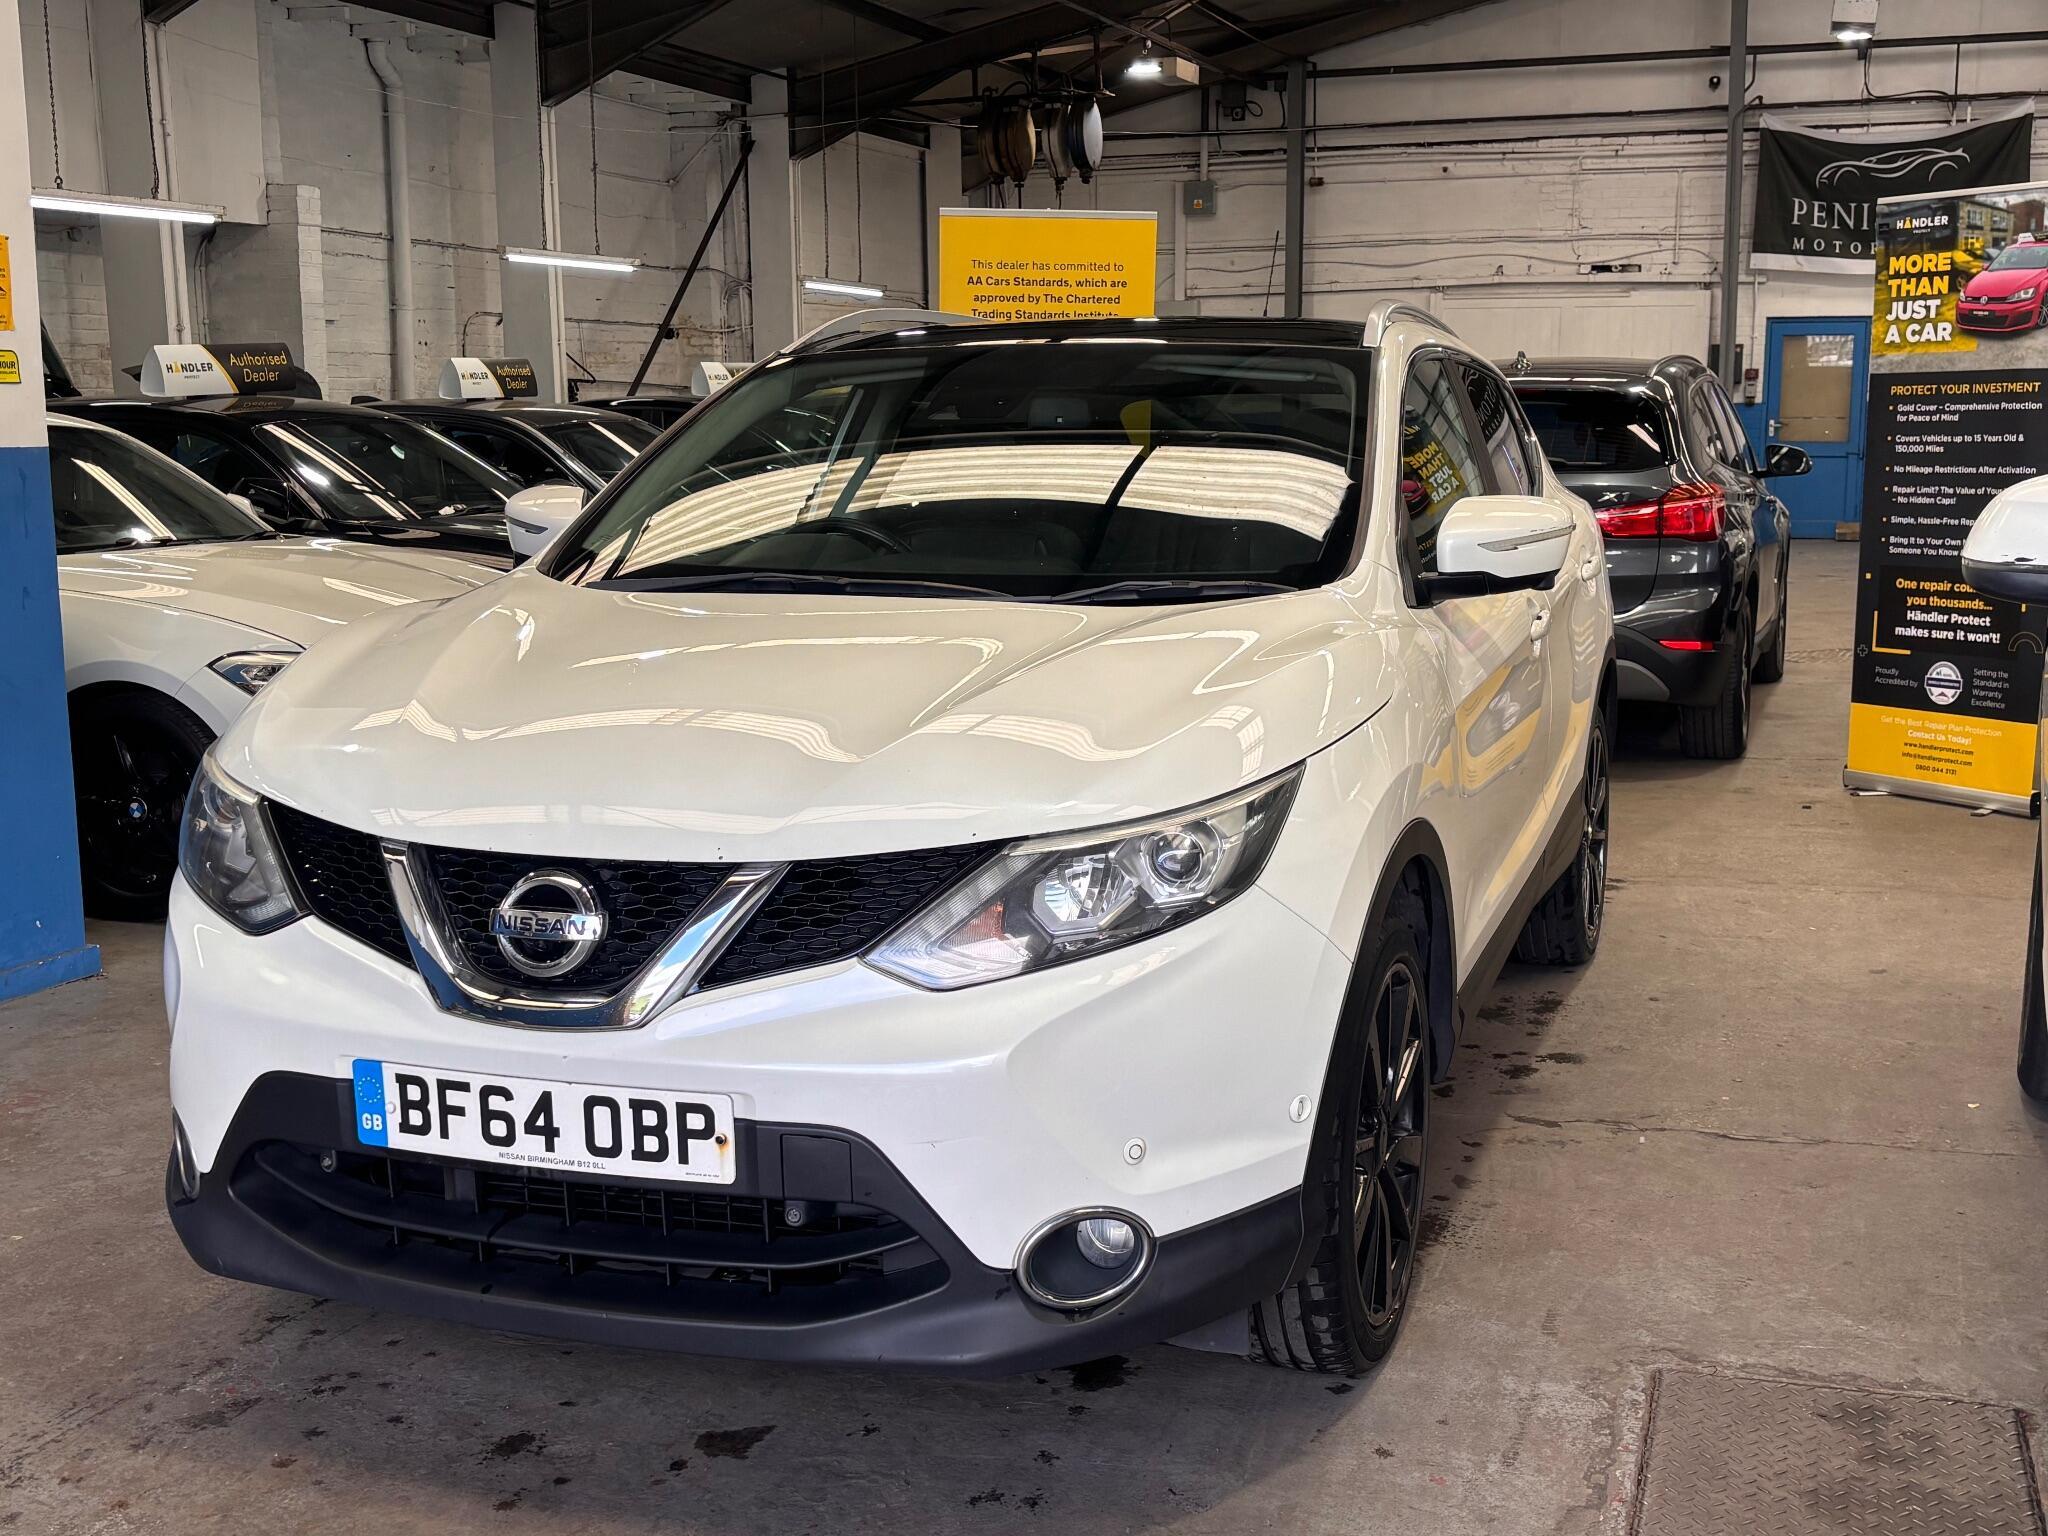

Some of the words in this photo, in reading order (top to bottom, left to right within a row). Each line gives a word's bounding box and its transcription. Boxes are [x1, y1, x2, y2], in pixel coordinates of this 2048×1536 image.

[1791, 197, 1877, 231] PENI
[971, 259, 993, 269] This
[996, 260, 1029, 270] dealer
[1032, 261, 1050, 270] has
[1054, 261, 1110, 272] committed
[1114, 263, 1124, 272] to
[1889, 252, 1952, 275] MORE
[967, 276, 983, 286] AA
[986, 276, 1011, 286] Cars
[1013, 277, 1072, 288] Standards,
[1075, 278, 1107, 288] which
[1888, 276, 1949, 297] THAN
[973, 293, 1025, 304] approved
[1028, 294, 1041, 304] by
[1043, 294, 1063, 304] The
[1066, 294, 1121, 305] Chartered
[971, 308, 1012, 320] Trading
[1015, 309, 1070, 320] Standards
[1886, 300, 1941, 321] JUST
[1884, 324, 1900, 344] A
[1906, 322, 1952, 343] CAR
[230, 351, 287, 367] Authorised
[243, 369, 279, 383] Dealer
[506, 377, 528, 389] Dealer
[1891, 385, 1937, 396] PROTECT
[1940, 384, 1970, 395] YOUR
[1973, 382, 2041, 394] INVESTMENT
[1898, 403, 1915, 412] Gold
[1945, 402, 1999, 412] Comprehensive
[2001, 401, 2043, 410] Protection
[1897, 414, 1907, 422] for
[1909, 414, 1930, 422] Peace
[1941, 413, 1959, 421] Mind
[1896, 435, 1920, 443] Covers
[1922, 434, 1951, 442] Vehicles
[1974, 434, 1981, 442] 15
[1983, 434, 2002, 442] Years
[2003, 434, 2016, 442] Old
[2018, 434, 2024, 442] &
[1895, 445, 1924, 453] 150,000
[1926, 444, 1944, 453] Miles
[1894, 465, 1904, 473] No
[1906, 465, 1932, 474] Mileage
[1934, 465, 1976, 474] Restrictions
[1978, 466, 1996, 474] After
[1998, 465, 2036, 474] Activation
[1892, 486, 1915, 495] Repair
[1917, 486, 1938, 494] Limit?
[1940, 486, 1954, 494] The
[1955, 486, 1975, 494] Value
[1977, 486, 1985, 494] of
[1898, 496, 1908, 504] No
[1909, 496, 1934, 504] Hidden
[1936, 497, 1956, 506] Caps!
[1890, 516, 1916, 525] Simple,
[1918, 516, 1959, 525] Hassle-Free
[1961, 518, 1975, 526] Rep
[1889, 536, 1908, 545] Bring
[1917, 537, 1925, 545] to
[1926, 537, 1943, 545] Your
[1944, 538, 1961, 546] Own
[1889, 546, 1921, 555] Someone
[1923, 547, 1937, 555] You
[1939, 548, 1959, 556] Know
[1896, 578, 1917, 589] One
[1920, 581, 1952, 592] repair
[1954, 583, 1976, 593] cou
[1906, 596, 1926, 607] you
[1929, 596, 1993, 610] thousands...
[1907, 610, 1949, 623] Händler
[1950, 613, 1991, 627] Protect
[1895, 626, 1929, 638] makes
[1931, 629, 1954, 640] sure
[1957, 629, 1965, 641] it
[1875, 666, 1899, 676] Proudly
[1973, 668, 1997, 678] Setting
[1998, 670, 2009, 679] the
[1874, 676, 1909, 687] Accredited
[1910, 679, 1918, 688] by
[1972, 678, 2003, 688] Standard
[1972, 689, 2003, 699] Warranty
[1971, 699, 2006, 709] Excellence
[1894, 717, 1906, 725] the
[1907, 718, 1922, 727] Best
[1948, 723, 1964, 732] Plan
[1965, 725, 2002, 737] Protection
[1907, 729, 1935, 740] Contact
[1936, 732, 1946, 741] Us
[1948, 734, 1972, 745] Today!
[497, 913, 587, 936] NISSAN
[362, 1112, 383, 1131] GB
[395, 1072, 560, 1153] BF64
[583, 1094, 716, 1165] OBP
[498, 1151, 526, 1162] NISSAN
[527, 1155, 576, 1167] BIRMINGHAM
[577, 1160, 591, 1168] B12
